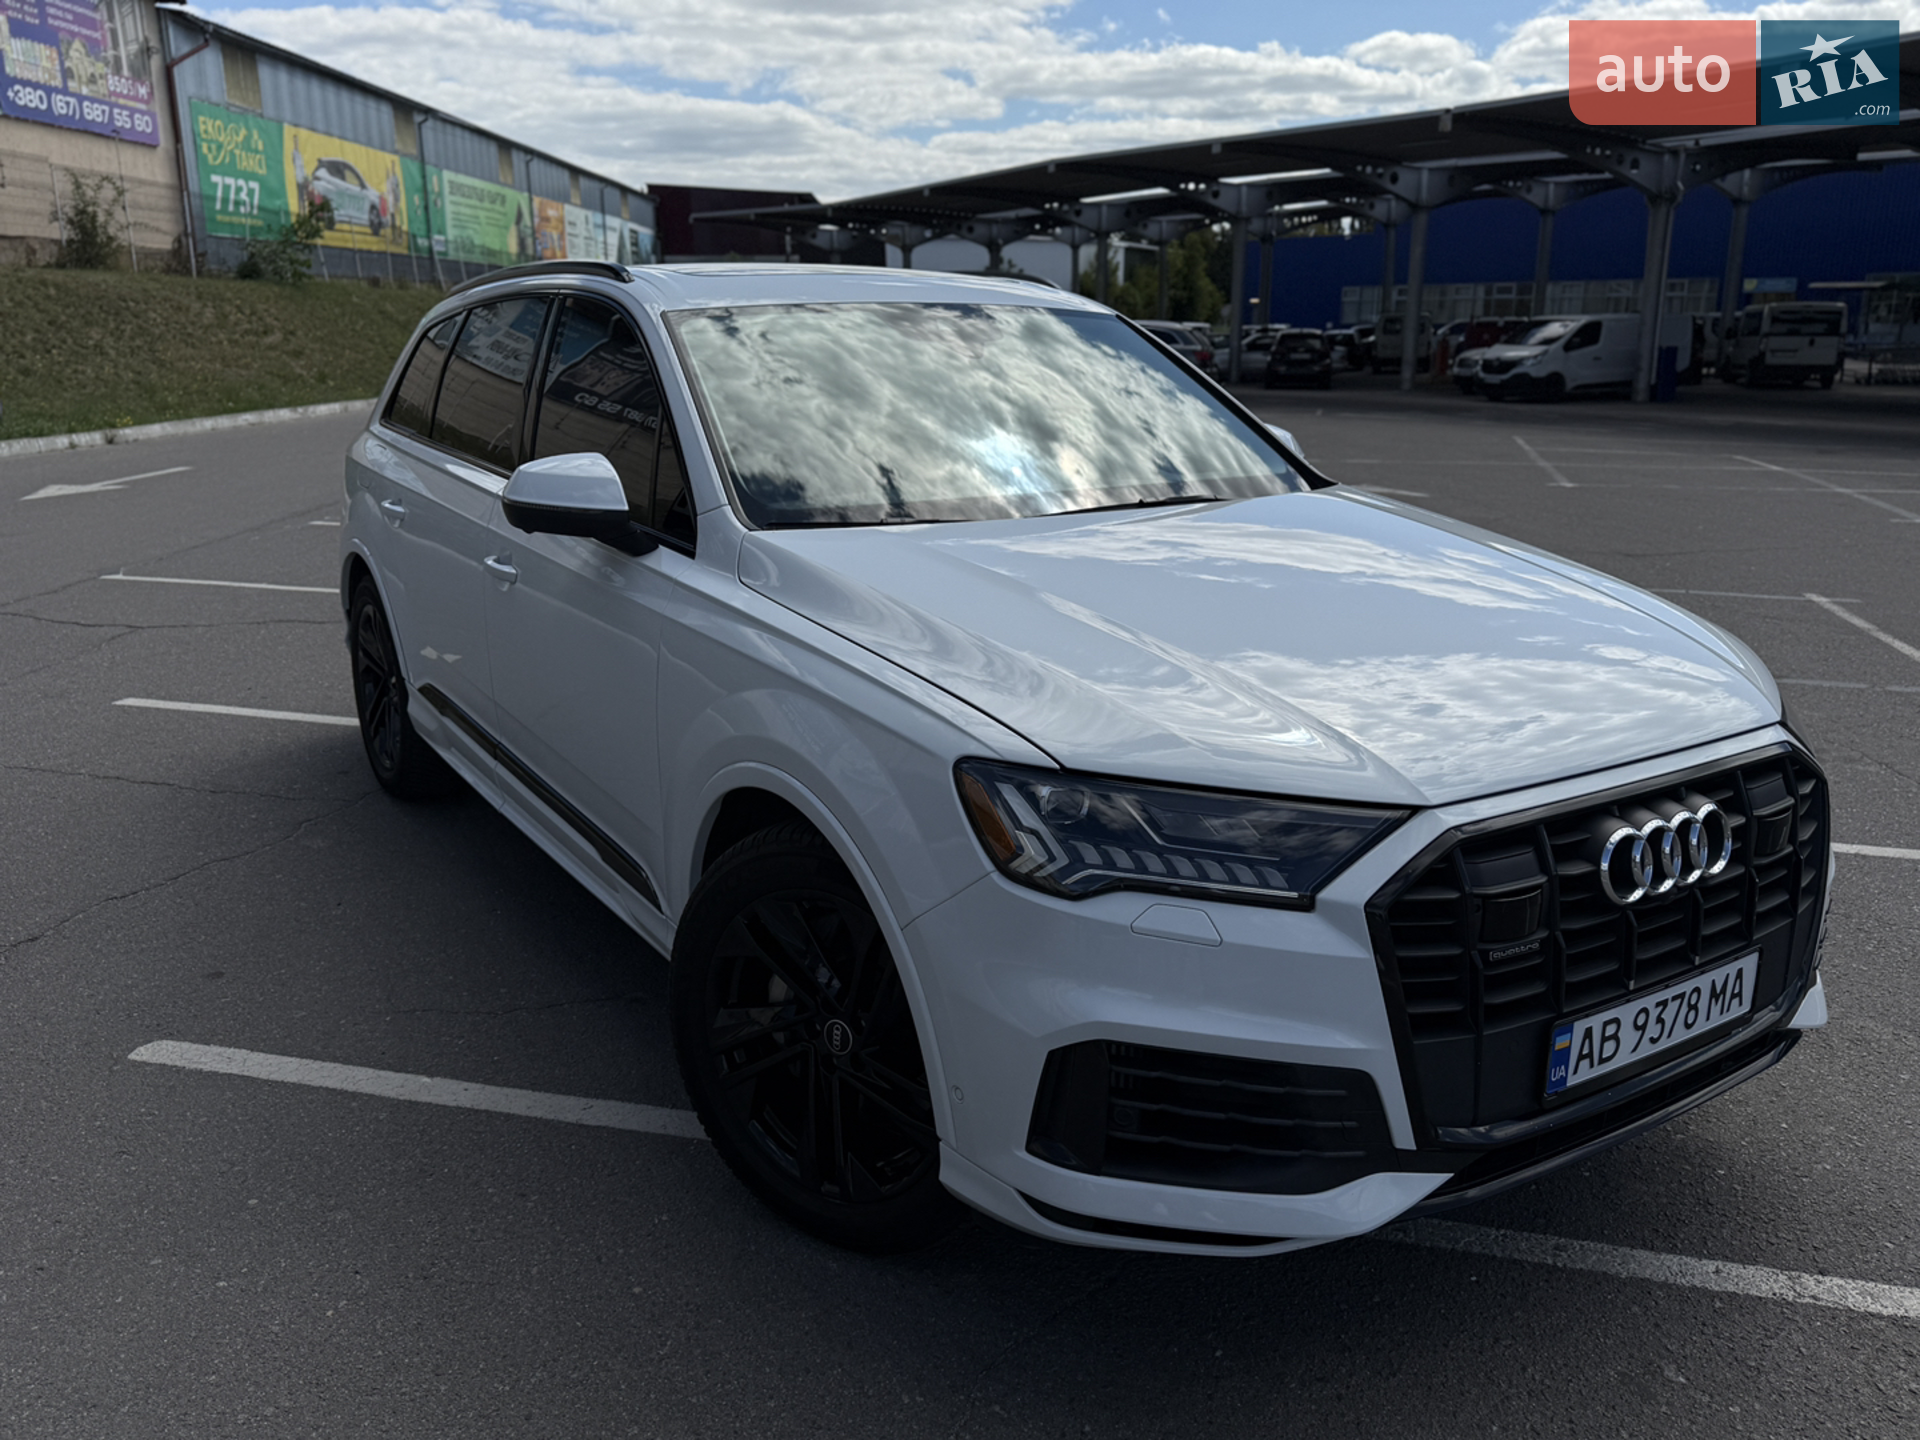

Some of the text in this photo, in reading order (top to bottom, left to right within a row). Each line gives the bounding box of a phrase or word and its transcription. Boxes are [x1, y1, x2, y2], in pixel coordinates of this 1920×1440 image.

[6, 84, 48, 111] +380
[51, 92, 80, 120] (67)
[82, 101, 109, 124] 687
[113, 107, 132, 129] 55
[133, 113, 153, 134] 60
[210, 174, 260, 216] 7737
[1493, 942, 1540, 959] quattro
[1572, 967, 1743, 1076] AB 9378 MA
[1551, 1065, 1566, 1081] UA
